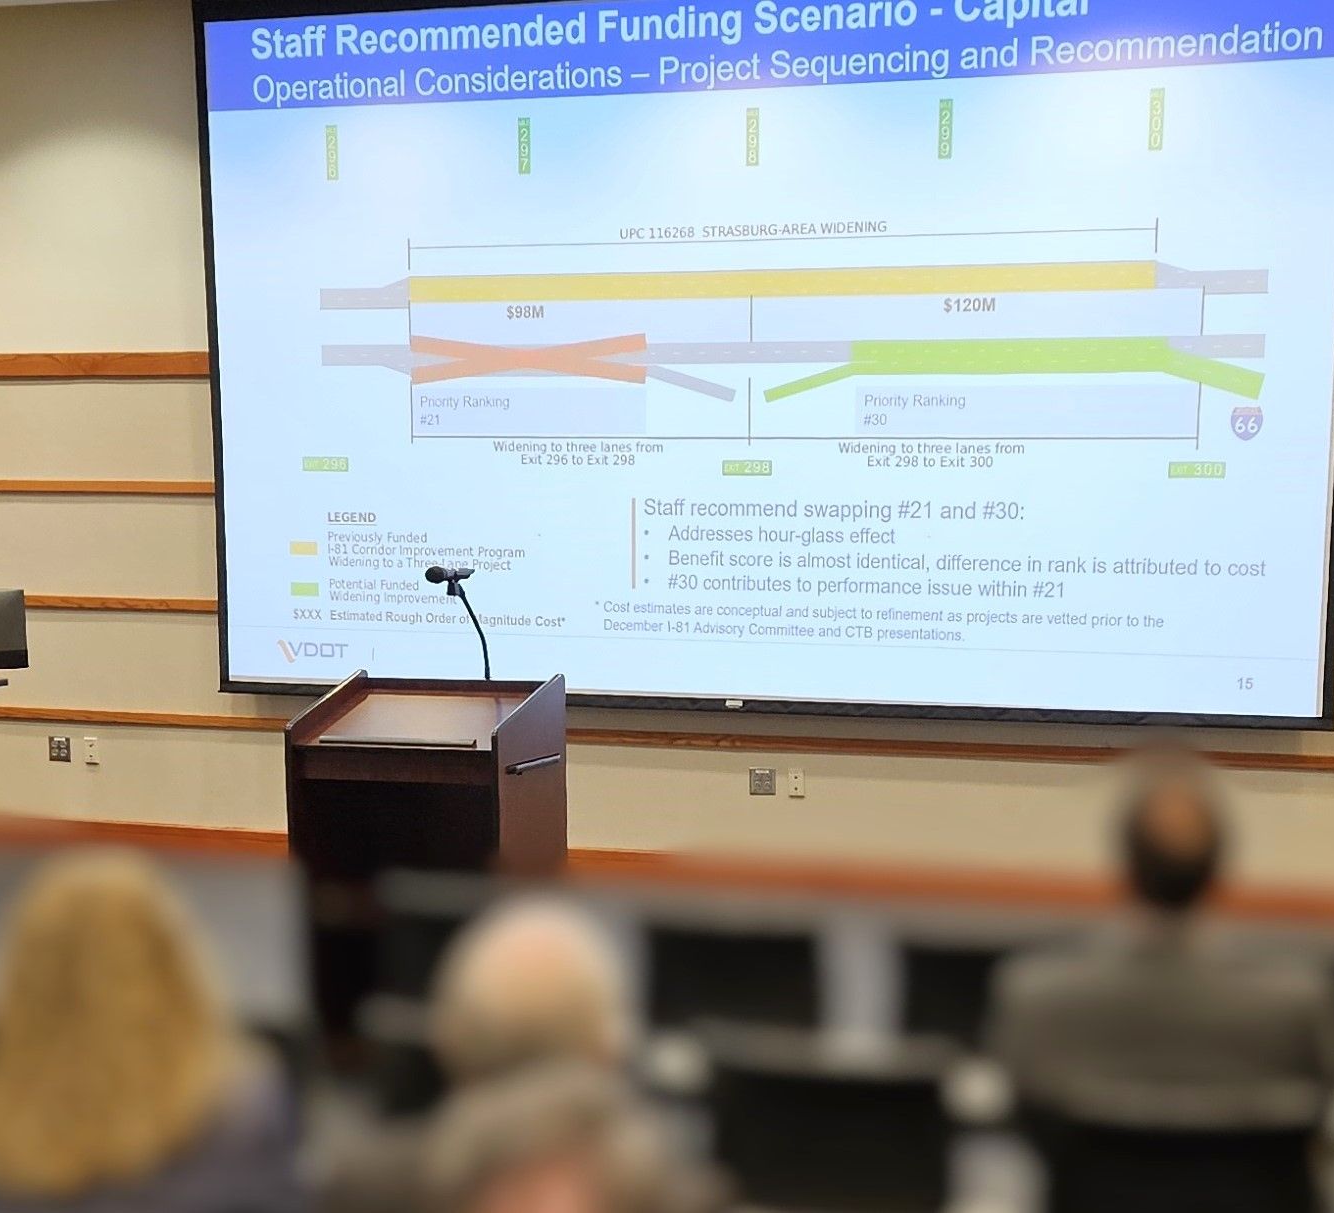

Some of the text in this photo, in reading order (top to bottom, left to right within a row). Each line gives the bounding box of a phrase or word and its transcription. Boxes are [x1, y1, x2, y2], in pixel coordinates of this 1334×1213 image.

[252, 25, 326, 59] Staff
[336, 12, 589, 57] Recommended
[598, 6, 741, 50] Funding
[754, 0, 918, 35] Scenario
[954, 0, 1090, 29] Capital
[253, 69, 405, 110] Operational
[415, 61, 622, 96] Considerations
[660, 50, 760, 89] Project
[771, 38, 949, 86] Sequencing
[960, 38, 1018, 69] and
[1031, 22, 1324, 65] Recommendation
[1151, 101, 1161, 147] 300
[748, 119, 757, 163] 298
[941, 111, 951, 155] 299
[520, 128, 528, 171] 297
[619, 220, 887, 239] UPC 116268 STRASBURG-AREA WIDENING
[507, 305, 544, 320] $98M
[943, 297, 995, 313] $120M
[420, 395, 509, 410] Priority Ranking
[865, 394, 965, 410] Priority Ranking
[420, 414, 439, 425] #21
[863, 413, 887, 425] #30
[1235, 417, 1259, 433] 66
[493, 440, 663, 455] Widening to three lanes from
[838, 441, 1024, 457] Widening to three lanes from
[521, 453, 635, 465] Exit 296 to Exit 298
[867, 455, 993, 468] Exit 298 to Exit 300
[745, 462, 770, 473] 298
[1194, 463, 1222, 476] 300
[327, 512, 377, 523] LEGEND
[644, 498, 1024, 523] Staff recommend swapping #21 and #30:
[327, 531, 427, 545] Previously Funded
[668, 525, 895, 547] Addresses hour-glass effect
[327, 544, 525, 559] I-81 Corridor Improvement Program
[328, 556, 379, 570] Widening
[382, 557, 393, 568] to
[397, 559, 403, 568] a
[473, 559, 511, 572] Project
[669, 550, 1266, 576] Benefit score is almost identical, difference in rank is attributed to cost
[329, 578, 419, 592] Potential Funded
[668, 573, 1063, 598] #30 contributes to performance issue within #21
[329, 591, 380, 604] Widening
[293, 608, 322, 620] $XXX
[330, 610, 382, 621] Estimated
[385, 611, 422, 625] Rough
[425, 612, 456, 624] Order
[603, 600, 629, 614] Cost
[633, 602, 691, 615] estimates
[694, 605, 713, 616] are
[717, 604, 782, 620] conceptual
[785, 606, 808, 617] and
[812, 606, 857, 621] subject
[861, 608, 872, 619] to
[876, 608, 943, 621] refinement
[947, 612, 962, 622] as
[966, 610, 1017, 626] projects
[1021, 614, 1043, 624] are
[1047, 612, 1087, 625] vetted
[1091, 614, 1123, 628] prior
[1127, 614, 1139, 627] to
[1143, 615, 1164, 628] the
[603, 618, 663, 632] December
[667, 620, 689, 633] I-81
[693, 621, 745, 638] Advisory
[749, 622, 814, 637] Committee
[818, 626, 841, 637] and
[845, 625, 872, 638] CTB
[281, 641, 349, 660] VDOT
[1237, 677, 1253, 690] 15
